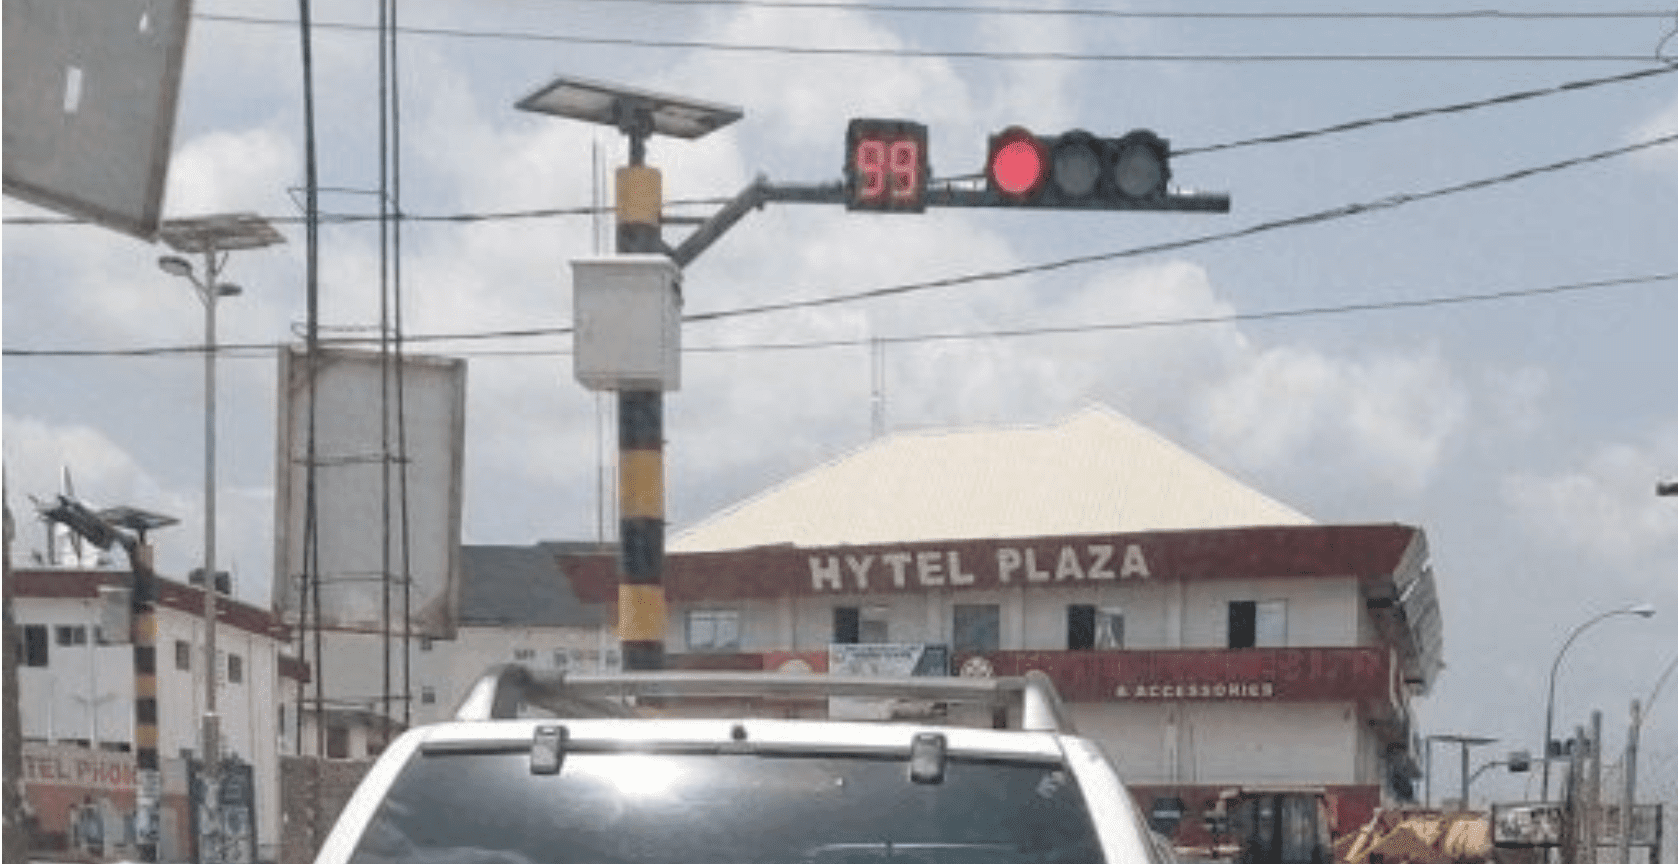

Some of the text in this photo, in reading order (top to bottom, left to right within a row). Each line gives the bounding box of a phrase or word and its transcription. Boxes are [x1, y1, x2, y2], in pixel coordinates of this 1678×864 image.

[857, 140, 917, 197] 99
[808, 544, 1150, 590] HYTEL PLAZA
[1134, 682, 1273, 698] ACCESSORIES
